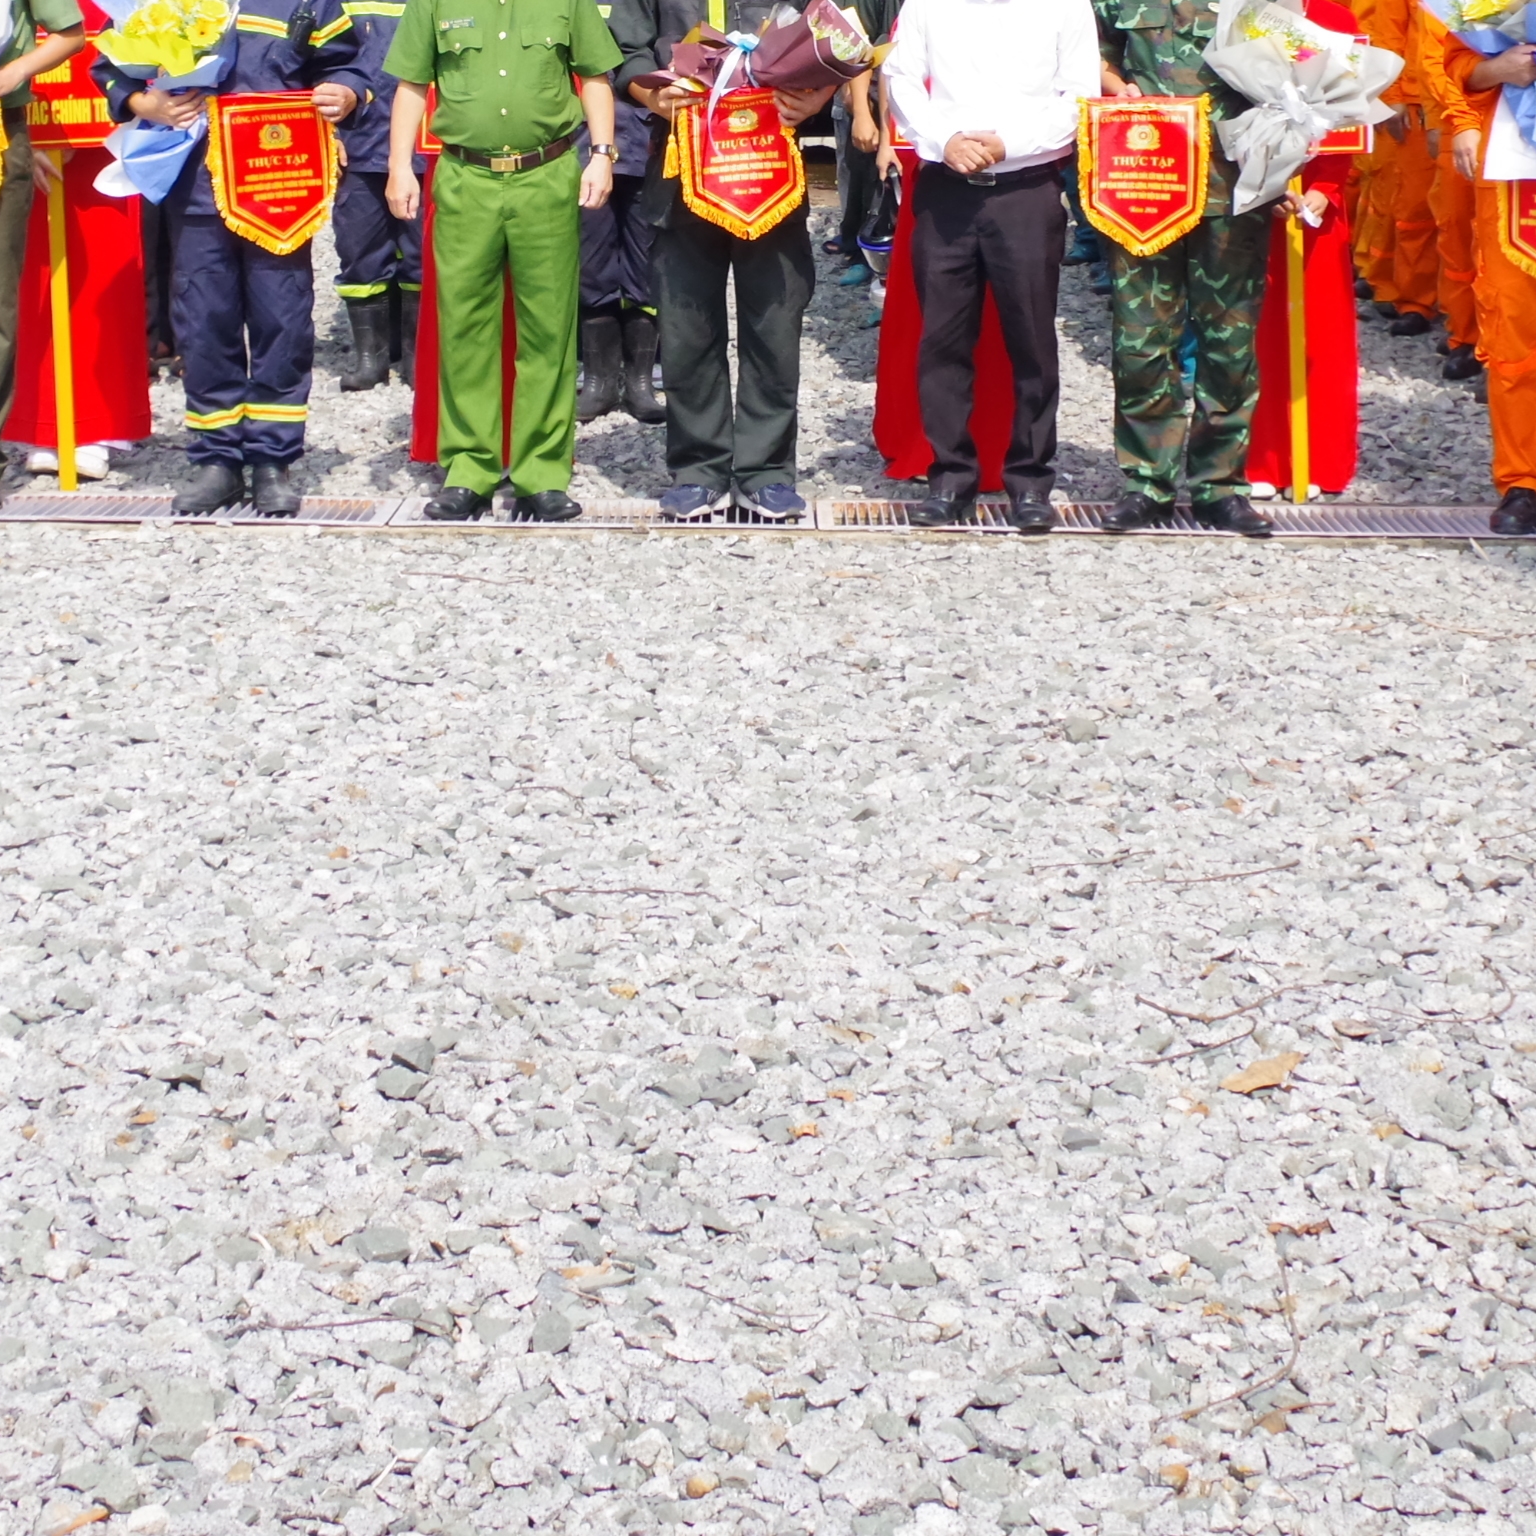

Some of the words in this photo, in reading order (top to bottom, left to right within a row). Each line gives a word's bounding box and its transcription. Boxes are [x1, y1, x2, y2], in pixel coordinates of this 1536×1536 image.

[51, 93, 92, 125] CHÍNH
[713, 137, 749, 150] THỰC
[750, 134, 775, 148] TẬP
[246, 154, 283, 169] THỰC
[284, 153, 309, 167] TẬP
[1111, 155, 1149, 168] THỰC
[1150, 156, 1176, 170] TẬP
